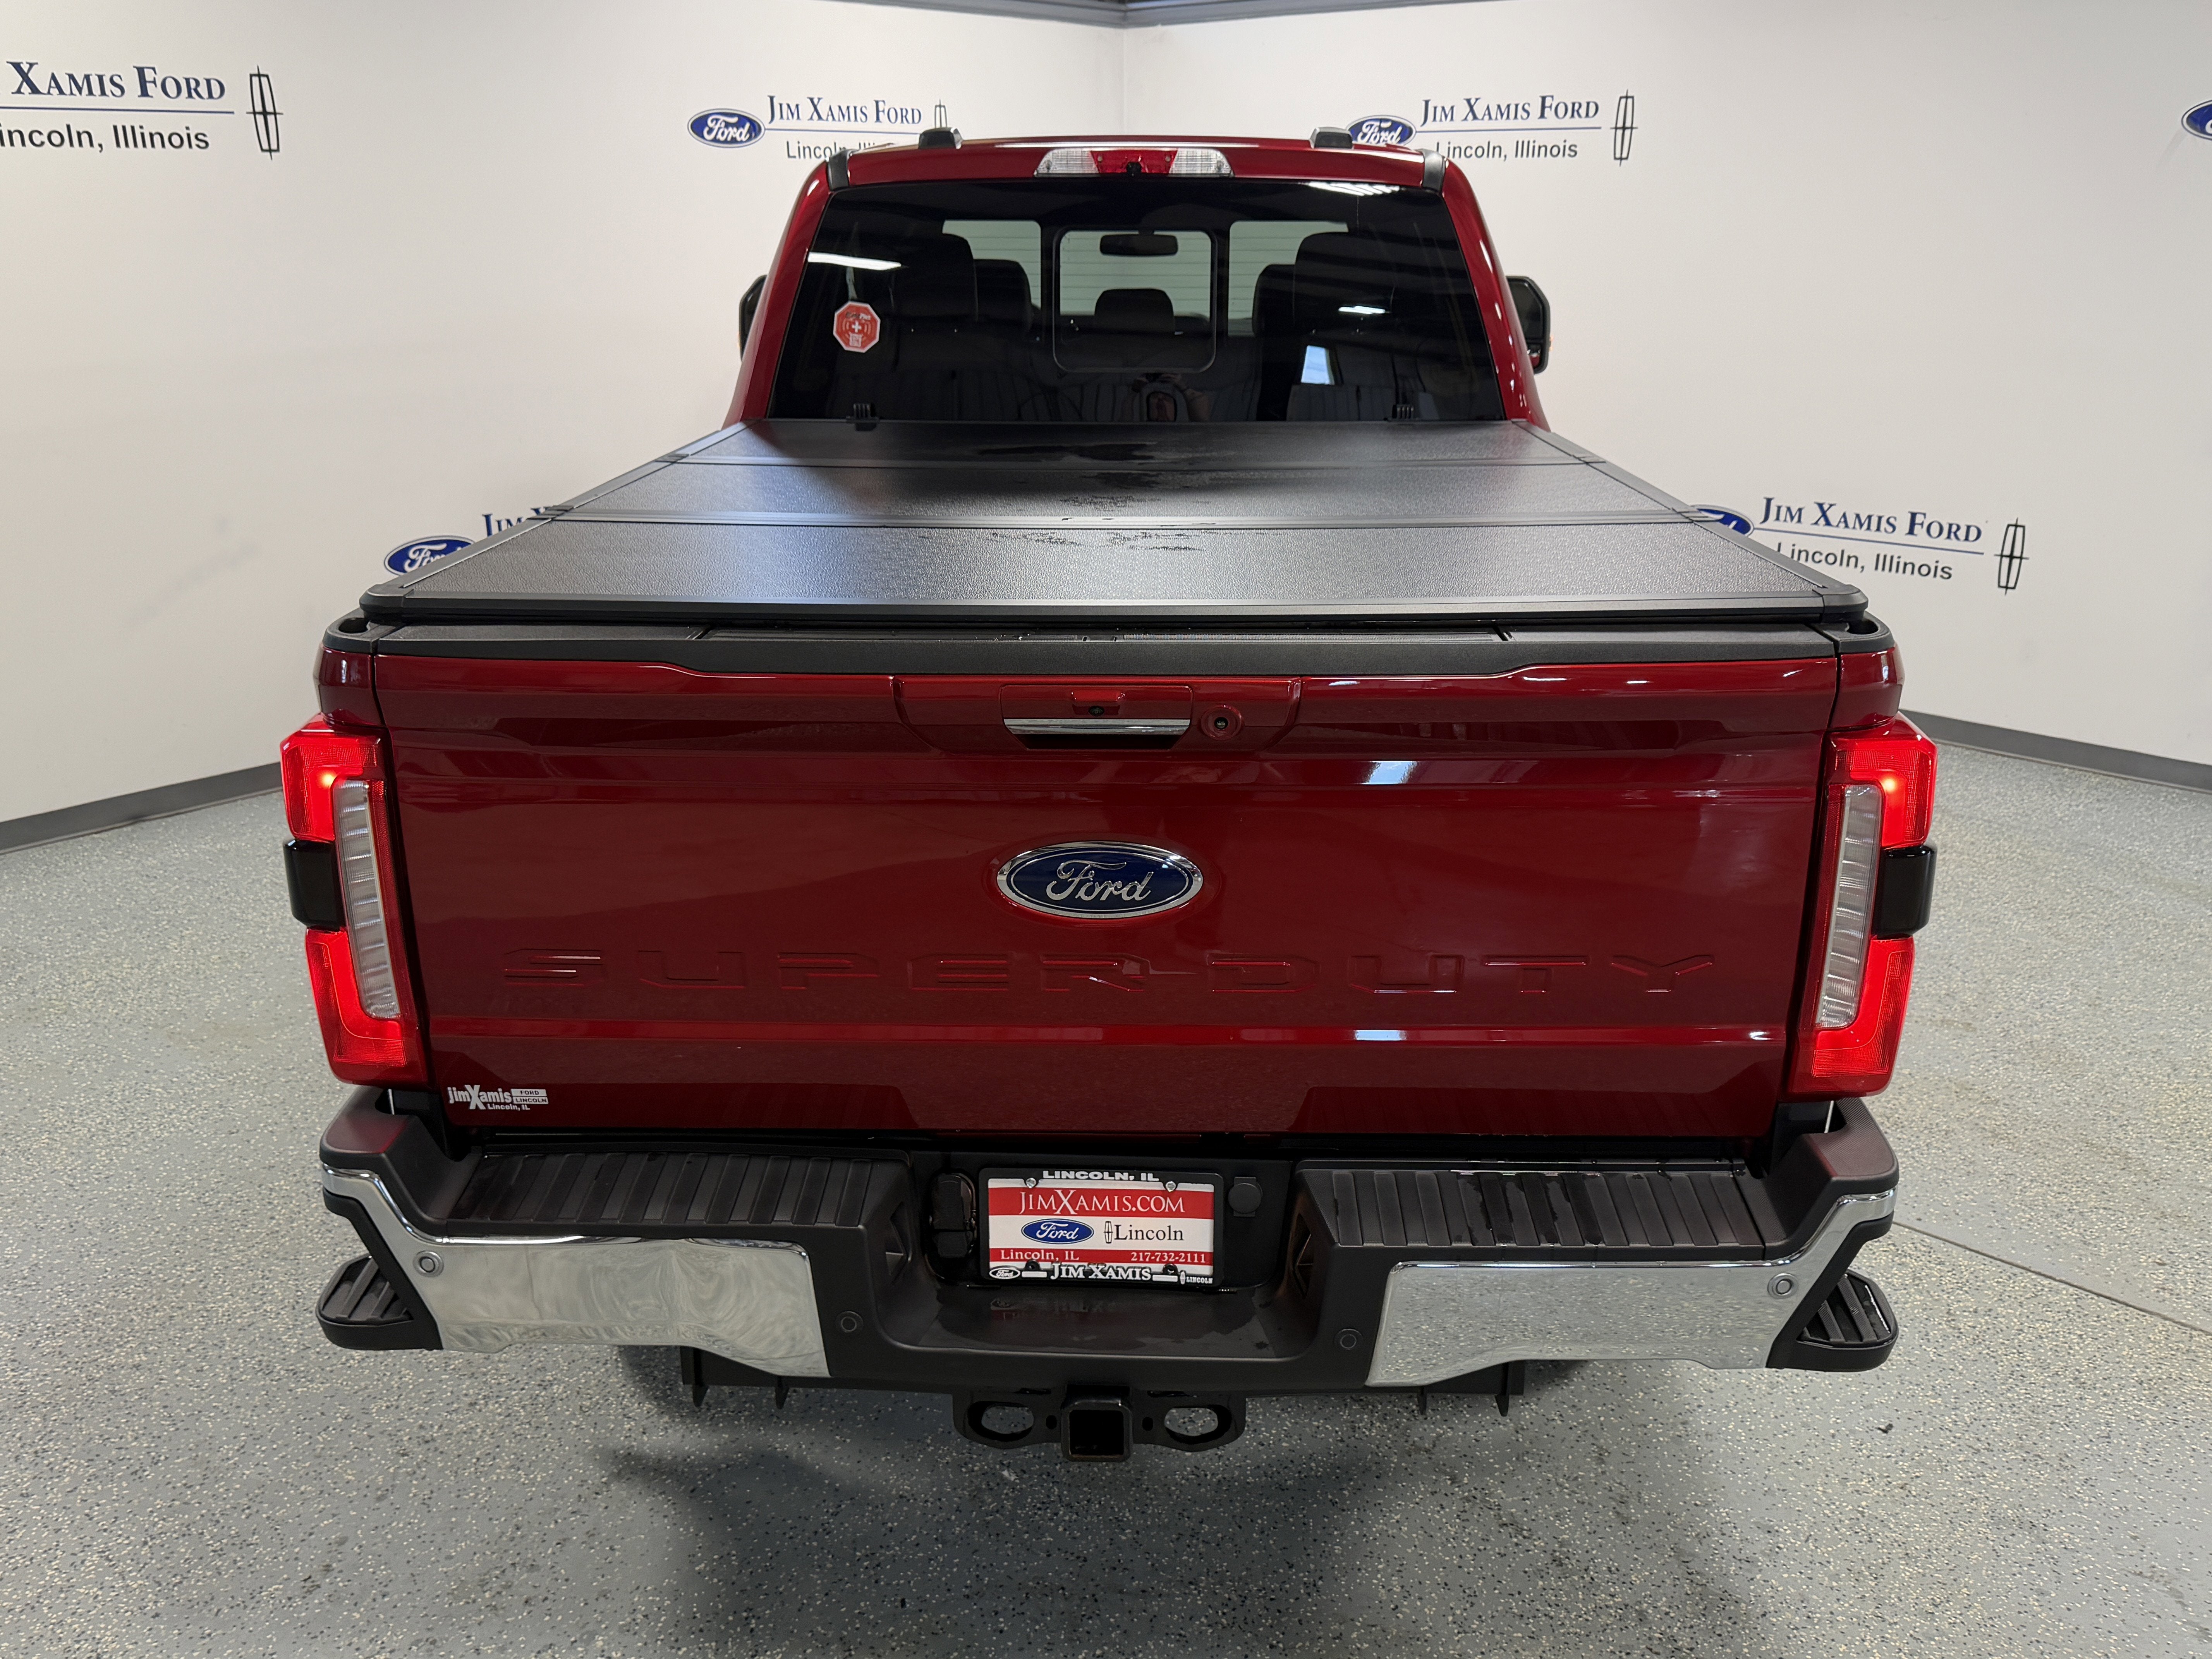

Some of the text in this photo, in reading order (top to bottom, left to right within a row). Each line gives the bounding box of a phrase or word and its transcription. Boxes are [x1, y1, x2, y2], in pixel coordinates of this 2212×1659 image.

[6, 61, 225, 100] XAMIS FORD
[767, 95, 922, 125] JIM XAMIS FORD
[1420, 94, 1599, 127] JIM XAMIS FORD
[0, 124, 210, 153] incoln, Illinois
[703, 115, 750, 142] Ford
[1357, 120, 1403, 144] Ford
[1515, 139, 1578, 158] Illinois
[1760, 497, 1805, 524] JIM
[1811, 501, 1897, 534] XAMIS
[1904, 511, 1982, 542] FORD
[1874, 553, 1953, 580] Illinois
[1046, 859, 1154, 901] Ford
[503, 948, 1716, 994] SUPER DUTY
[447, 1084, 512, 1109] jimXamis
[1043, 1170, 1159, 1182] LINCOLN, IL
[1019, 1190, 1185, 1215] JIMXAMIS.COM
[1036, 1223, 1079, 1239] Ford
[1114, 1224, 1185, 1241] Lincoln
[1065, 1251, 1079, 1261] IL
[1130, 1252, 1206, 1263] 217-732-2111
[996, 1269, 1013, 1277] Ford
[1050, 1262, 1151, 1281] JIM XAMIS
